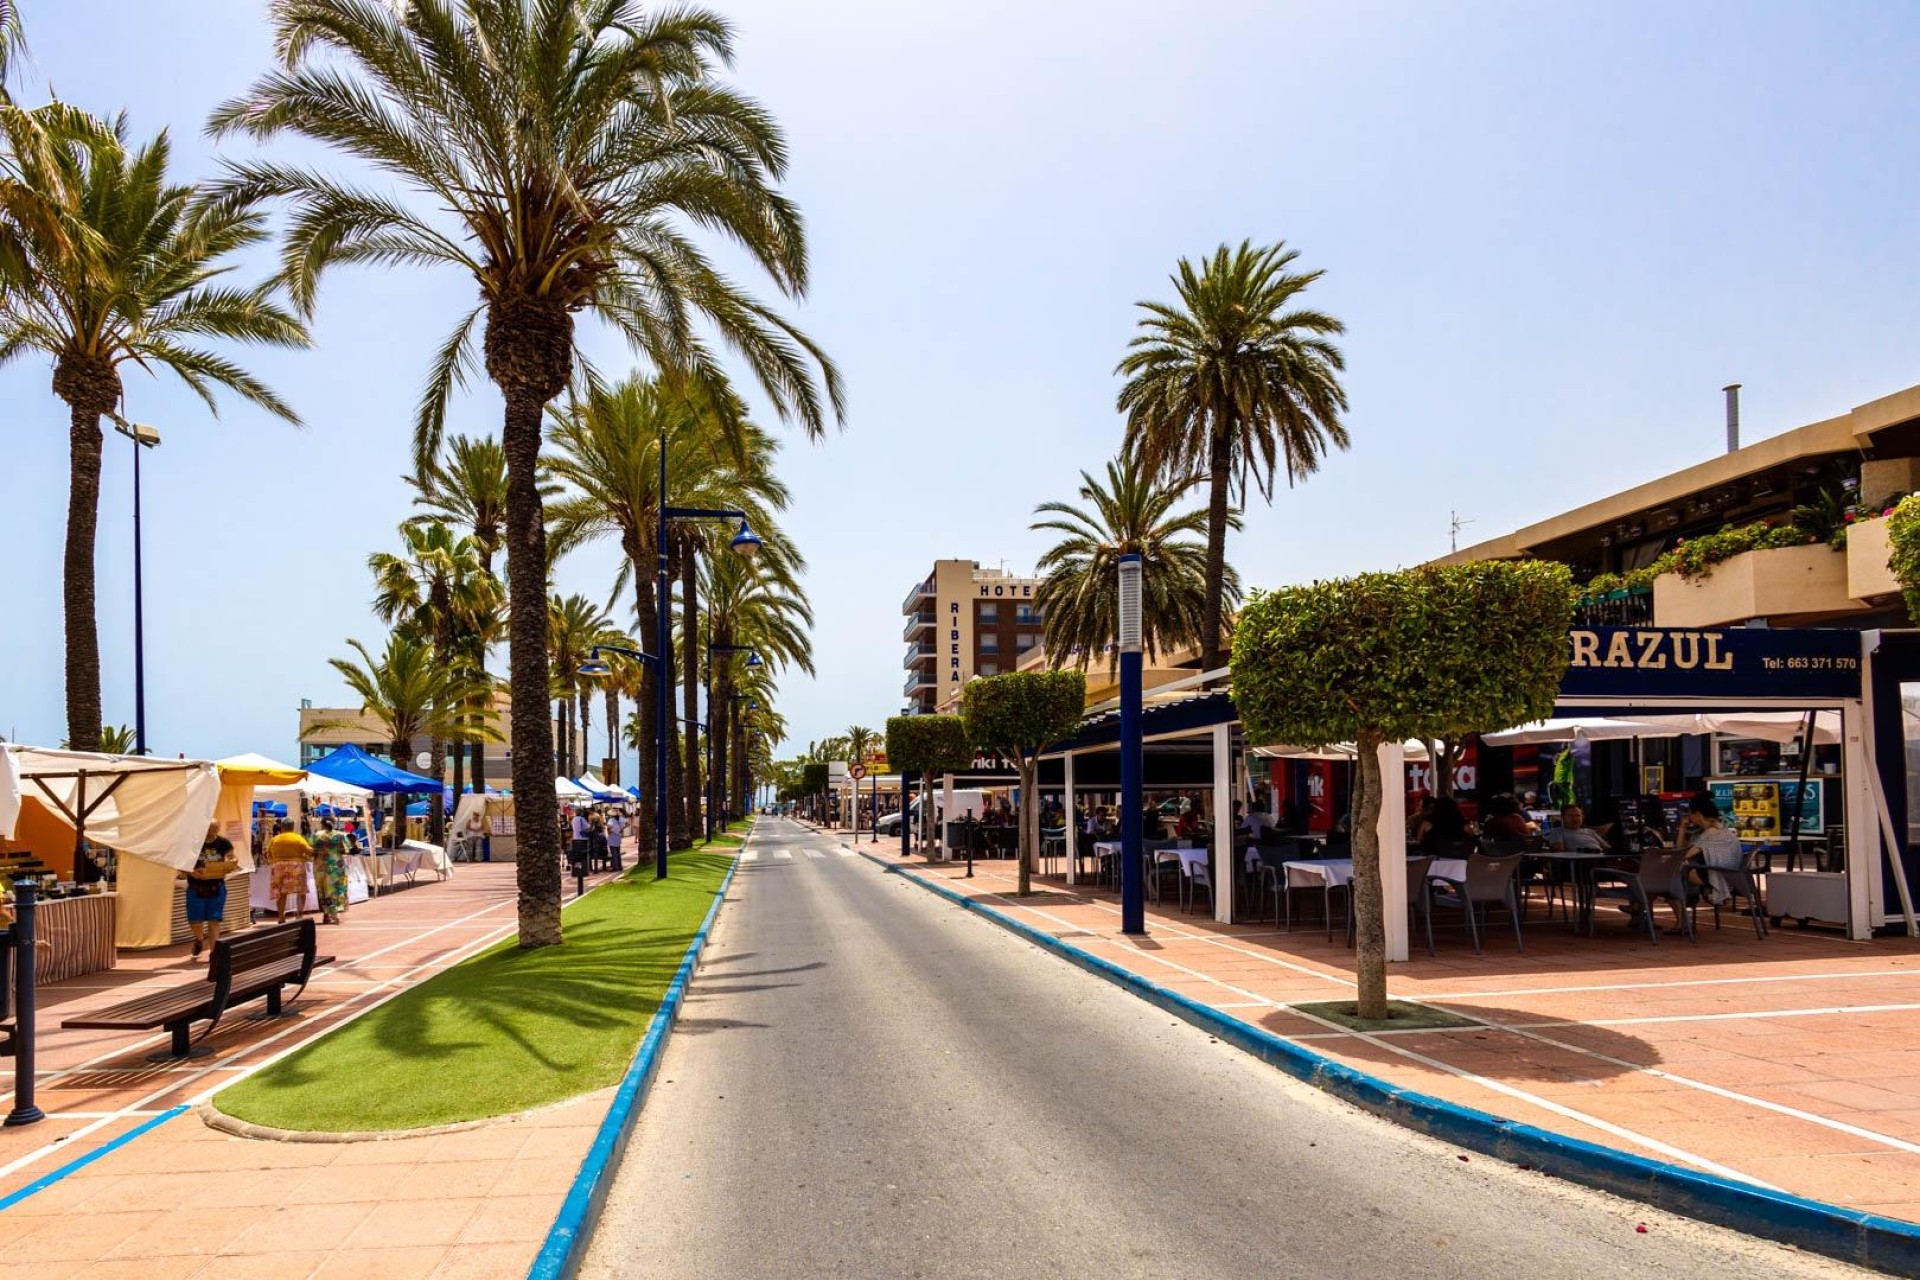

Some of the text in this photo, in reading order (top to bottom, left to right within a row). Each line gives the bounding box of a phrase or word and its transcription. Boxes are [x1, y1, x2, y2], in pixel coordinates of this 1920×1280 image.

[980, 585, 1031, 596] HOTE
[950, 602, 959, 682] RIBERA
[1569, 630, 1733, 670] RAZUL
[1762, 657, 1856, 669] Tel: 663 371 570
